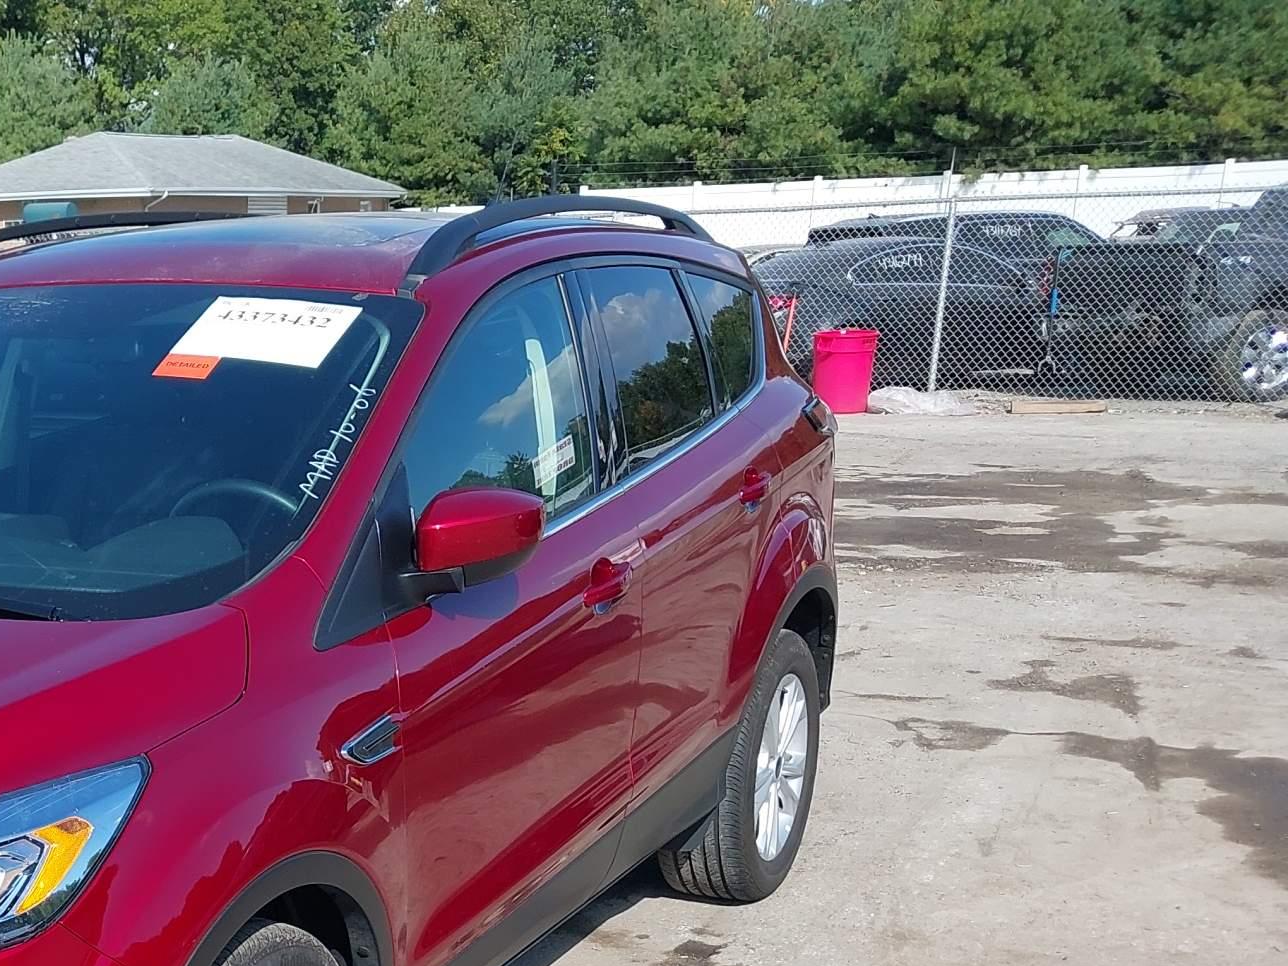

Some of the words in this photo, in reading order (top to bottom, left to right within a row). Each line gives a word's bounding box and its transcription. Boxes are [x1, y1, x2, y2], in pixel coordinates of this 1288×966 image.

[217, 310, 331, 328] 43373432
[165, 361, 210, 369] DETAILED
[299, 449, 340, 499] MAD
